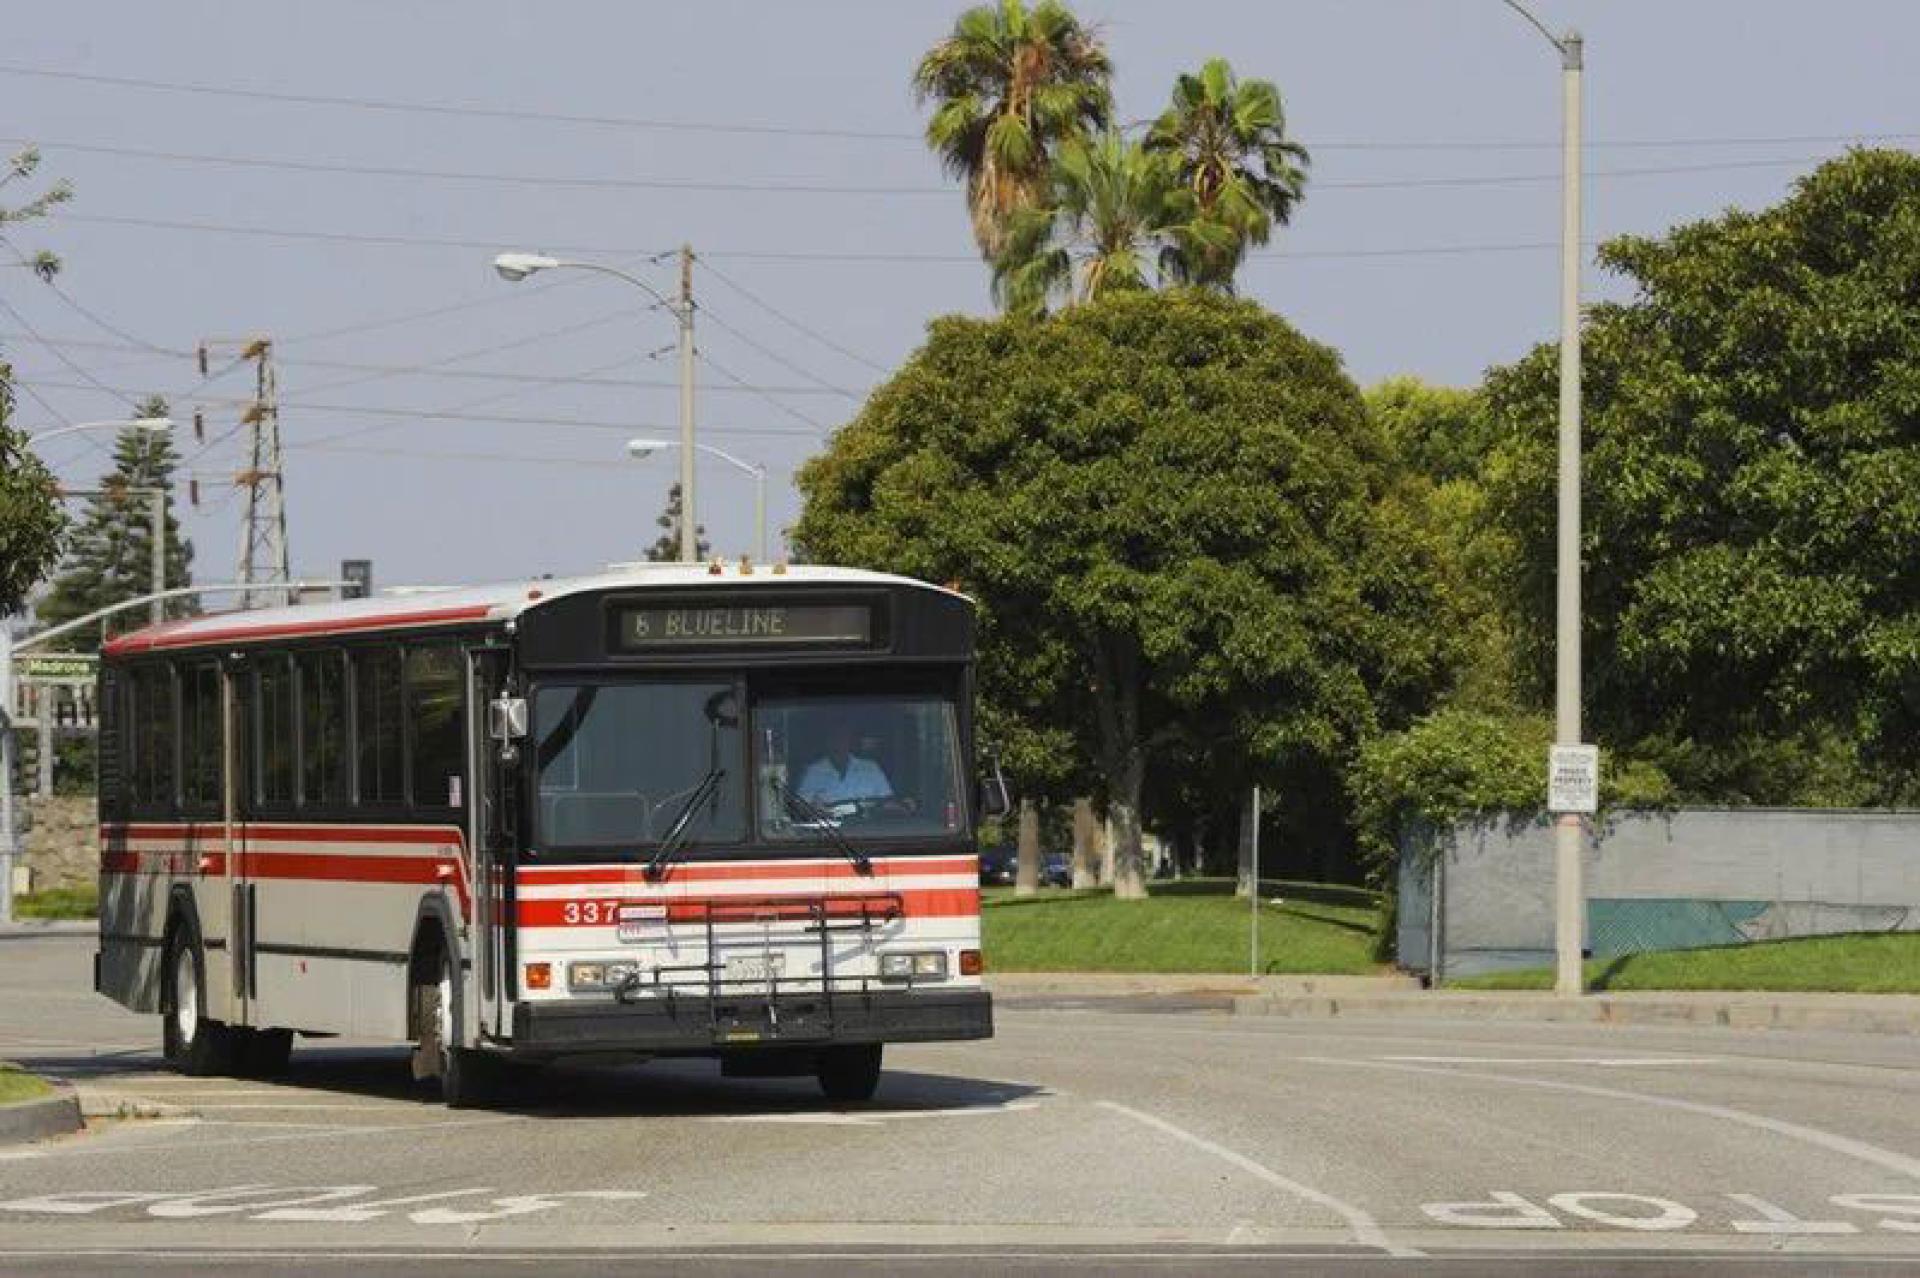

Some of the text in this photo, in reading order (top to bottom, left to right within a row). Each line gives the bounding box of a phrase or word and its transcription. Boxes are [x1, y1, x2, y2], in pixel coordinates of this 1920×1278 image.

[665, 608, 786, 635] BLUELINE
[564, 902, 618, 923] 337
[1419, 1190, 1920, 1233] STOP
